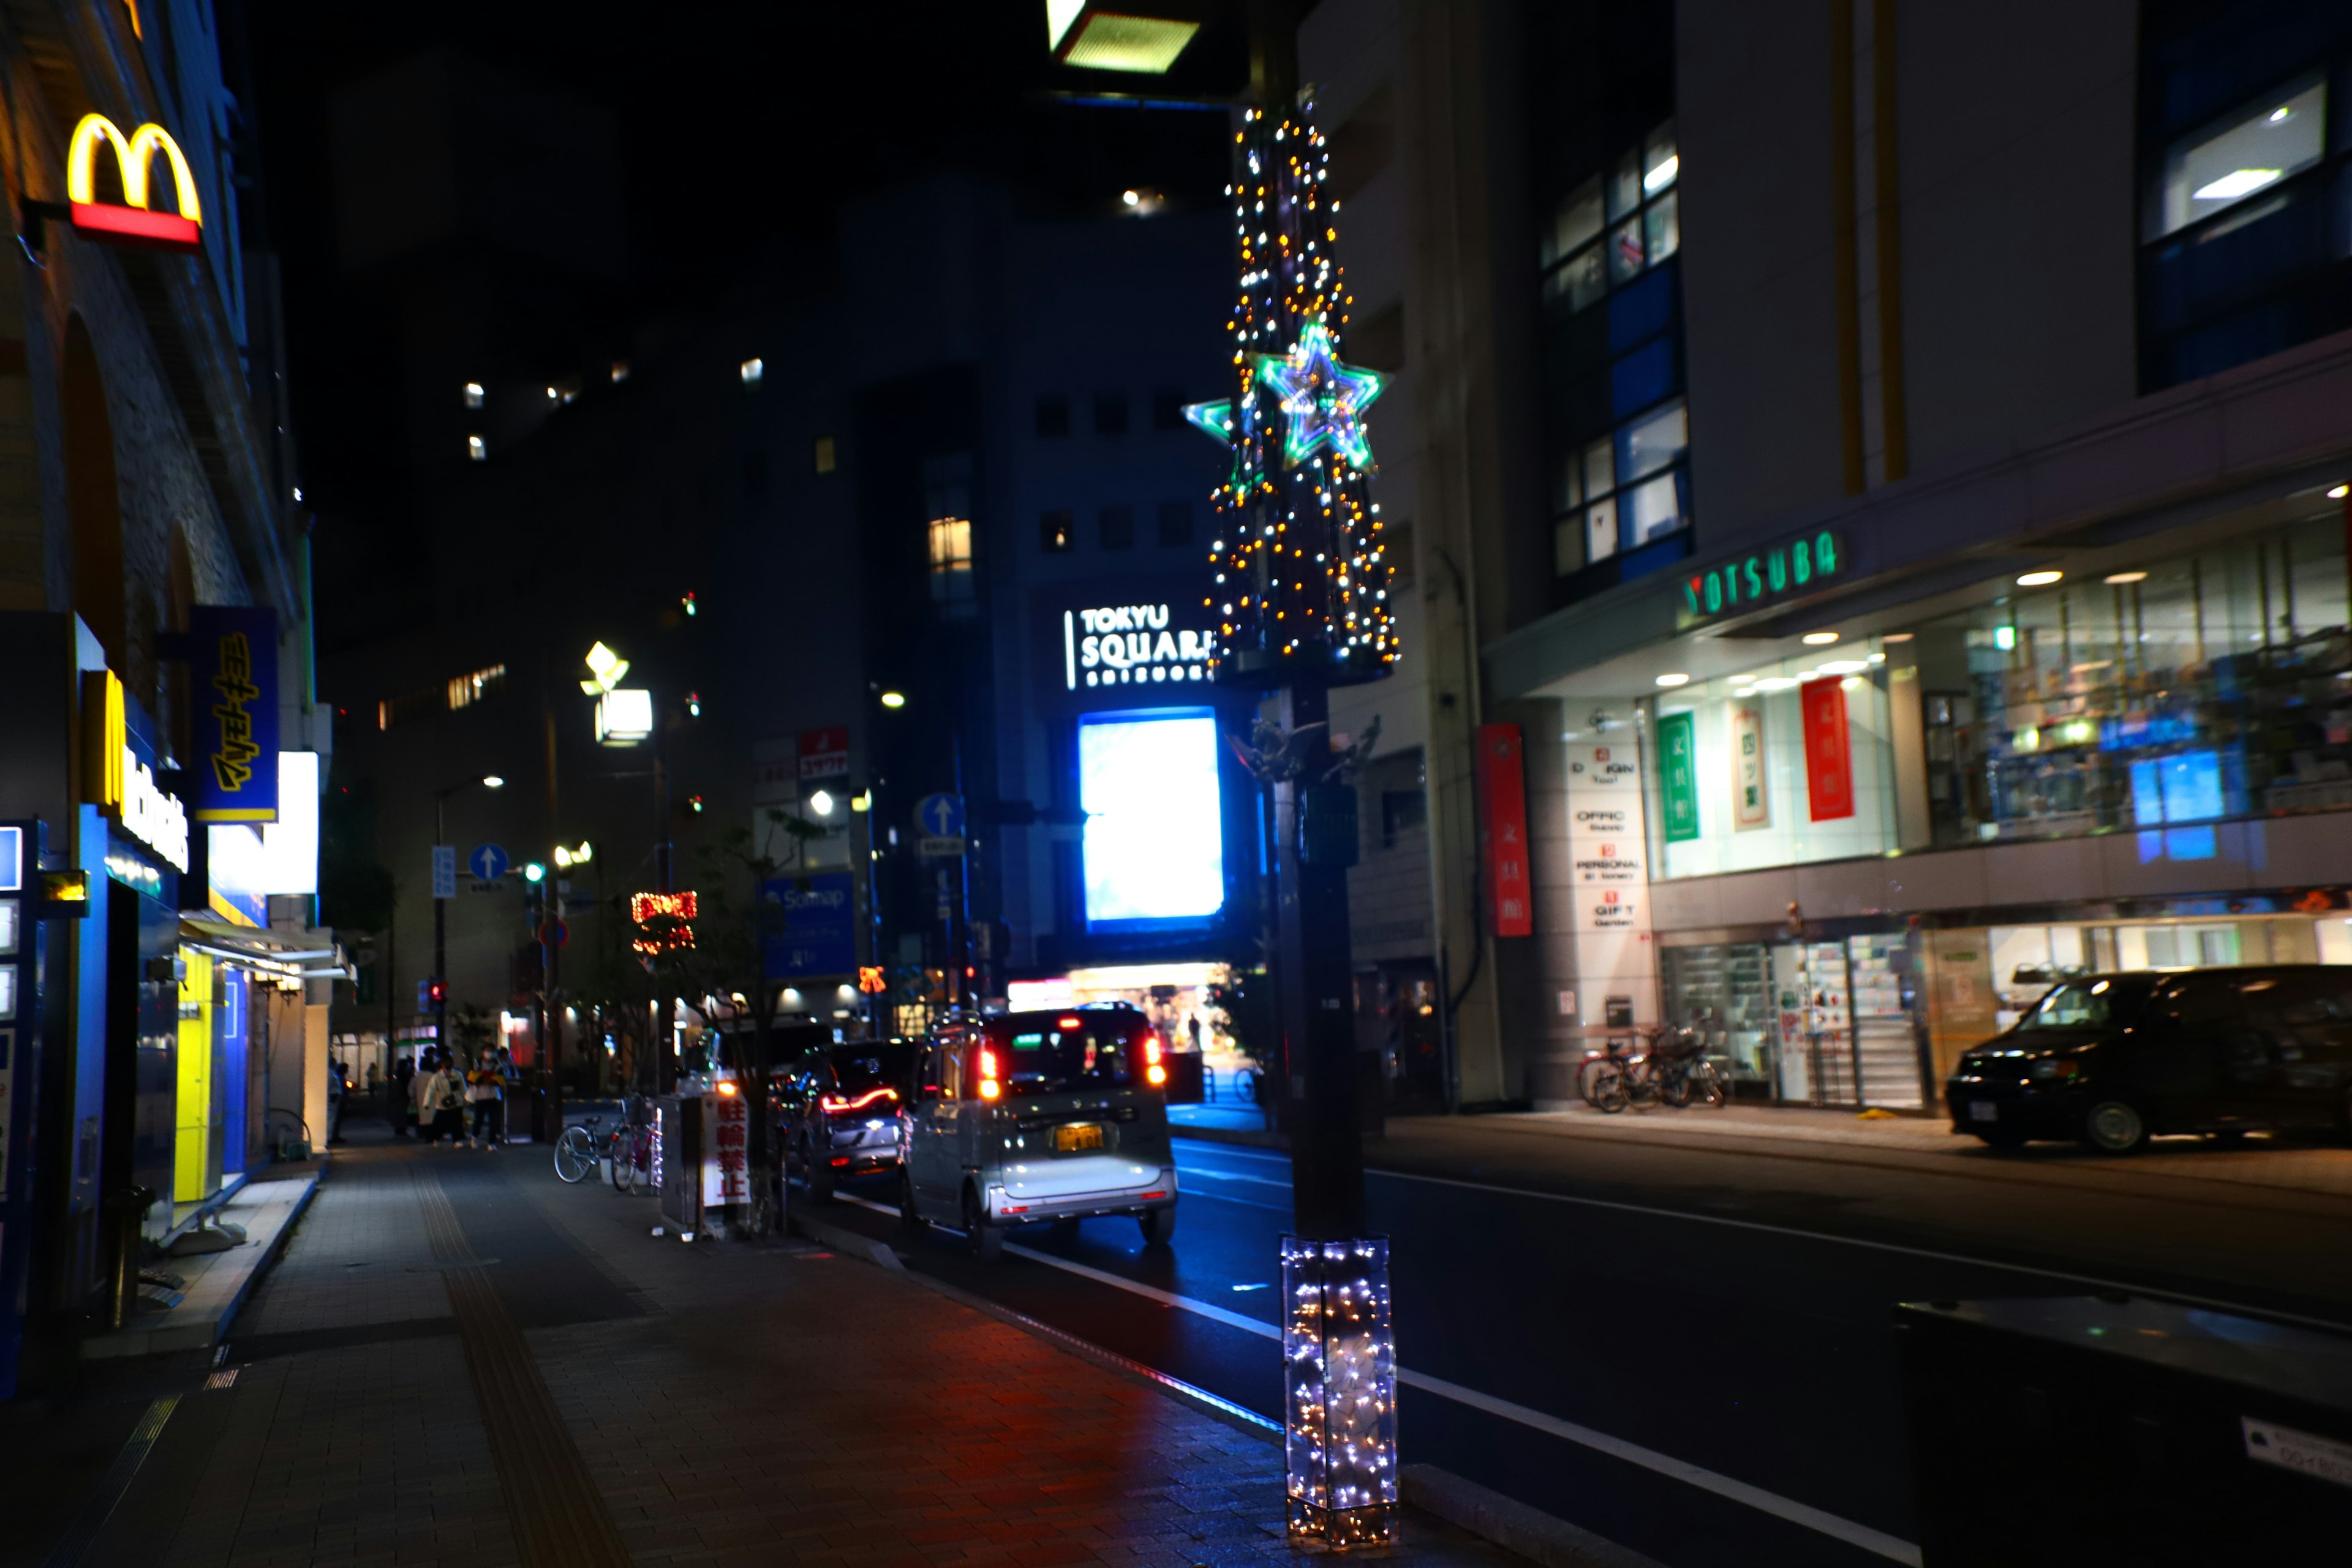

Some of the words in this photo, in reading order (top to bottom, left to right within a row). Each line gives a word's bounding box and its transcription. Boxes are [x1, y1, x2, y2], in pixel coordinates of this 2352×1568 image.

[1683, 530, 1836, 615] YOTSUBA
[1080, 604, 1169, 634] TOKYU
[1087, 665, 1215, 687] SHIZUOK
[211, 631, 259, 791] マツモトキヨシ
[1577, 860, 1642, 870] PERSONAL
[1595, 905, 1635, 916] GIFT
[717, 1100, 745, 1197] 駐輪禁止
